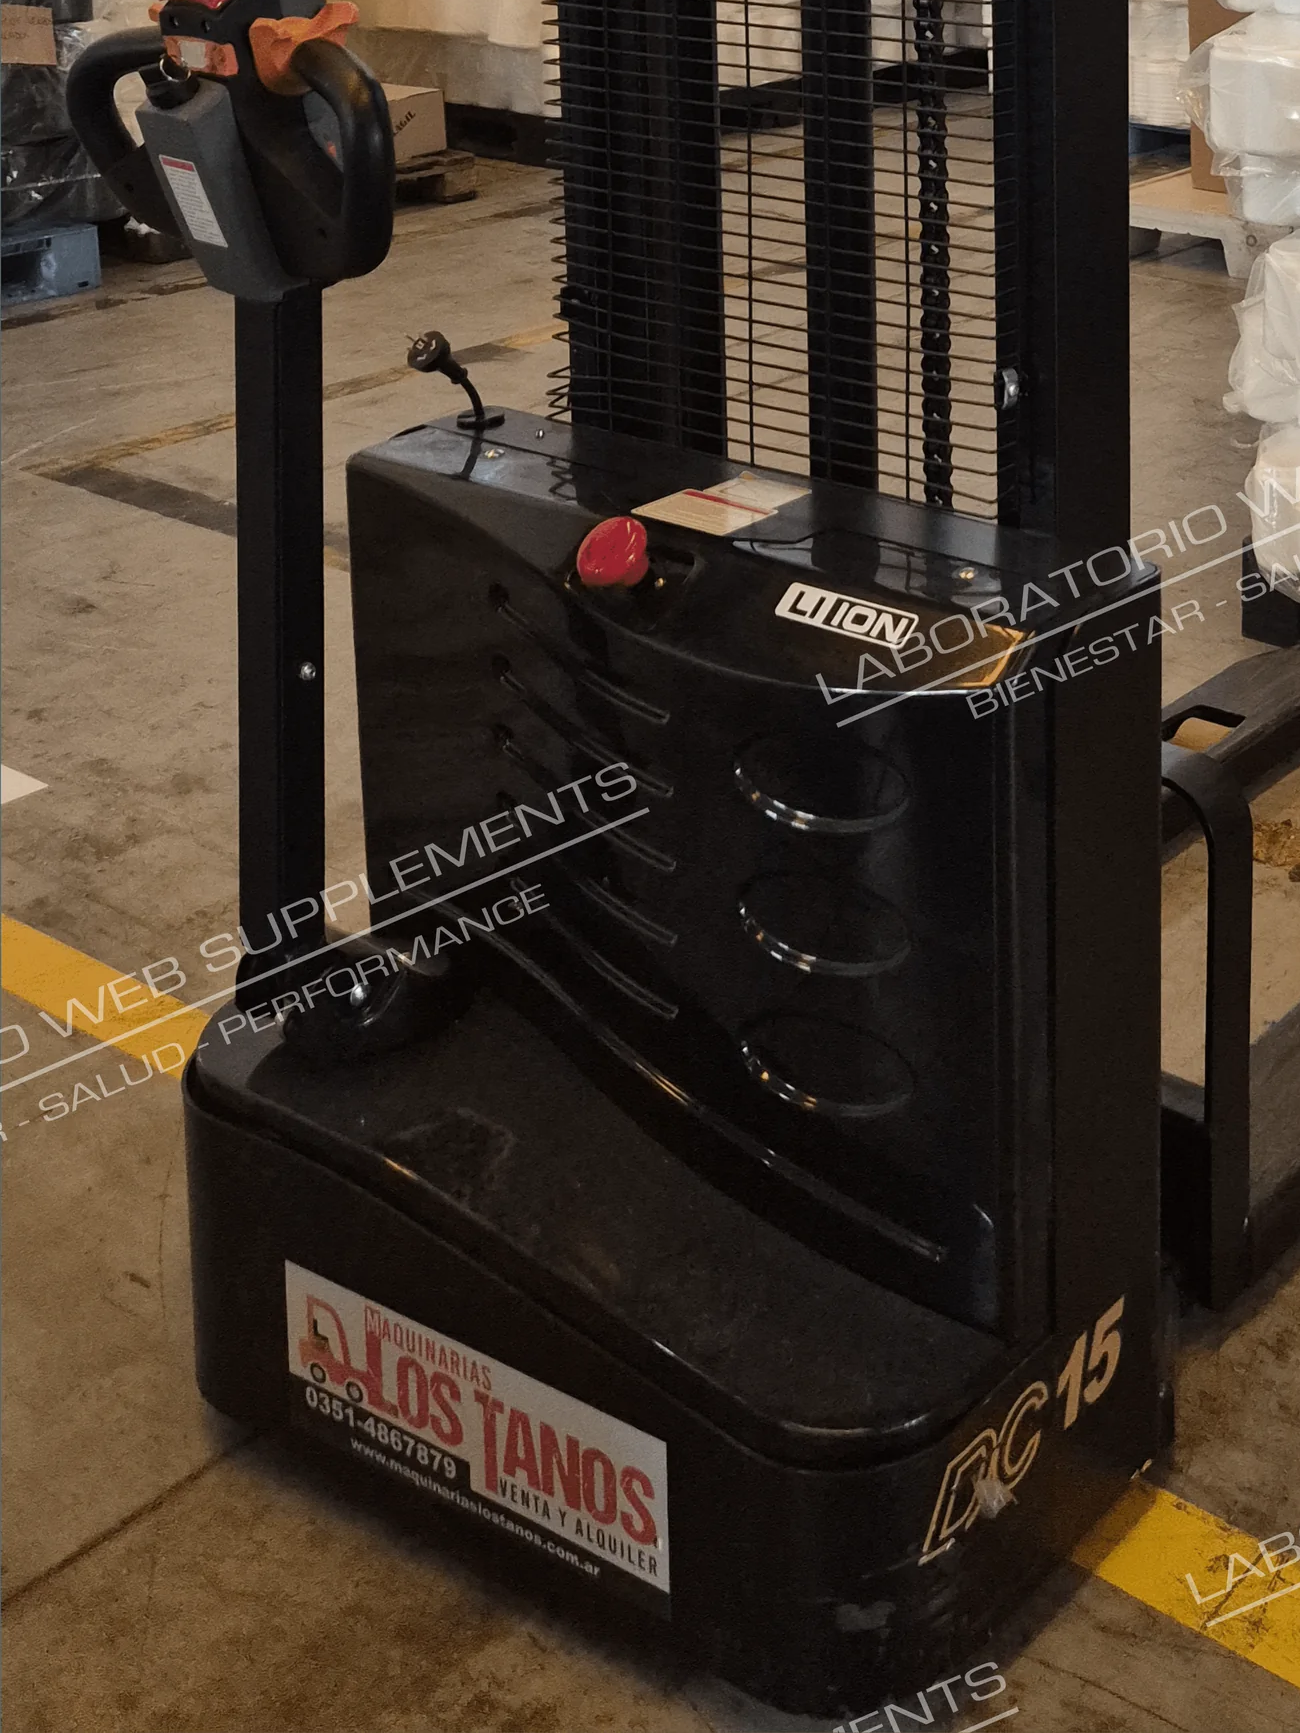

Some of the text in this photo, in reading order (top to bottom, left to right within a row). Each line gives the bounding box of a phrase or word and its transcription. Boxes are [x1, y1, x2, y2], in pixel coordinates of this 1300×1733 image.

[364, 1303, 493, 1391] MAQUINARIAS
[1056, 1294, 1126, 1431] 15
[305, 1386, 457, 1480] 0351-4867879
[364, 1330, 657, 1546] LOS TANOS
[499, 1477, 658, 1578] VENTA Y ALQUILER
